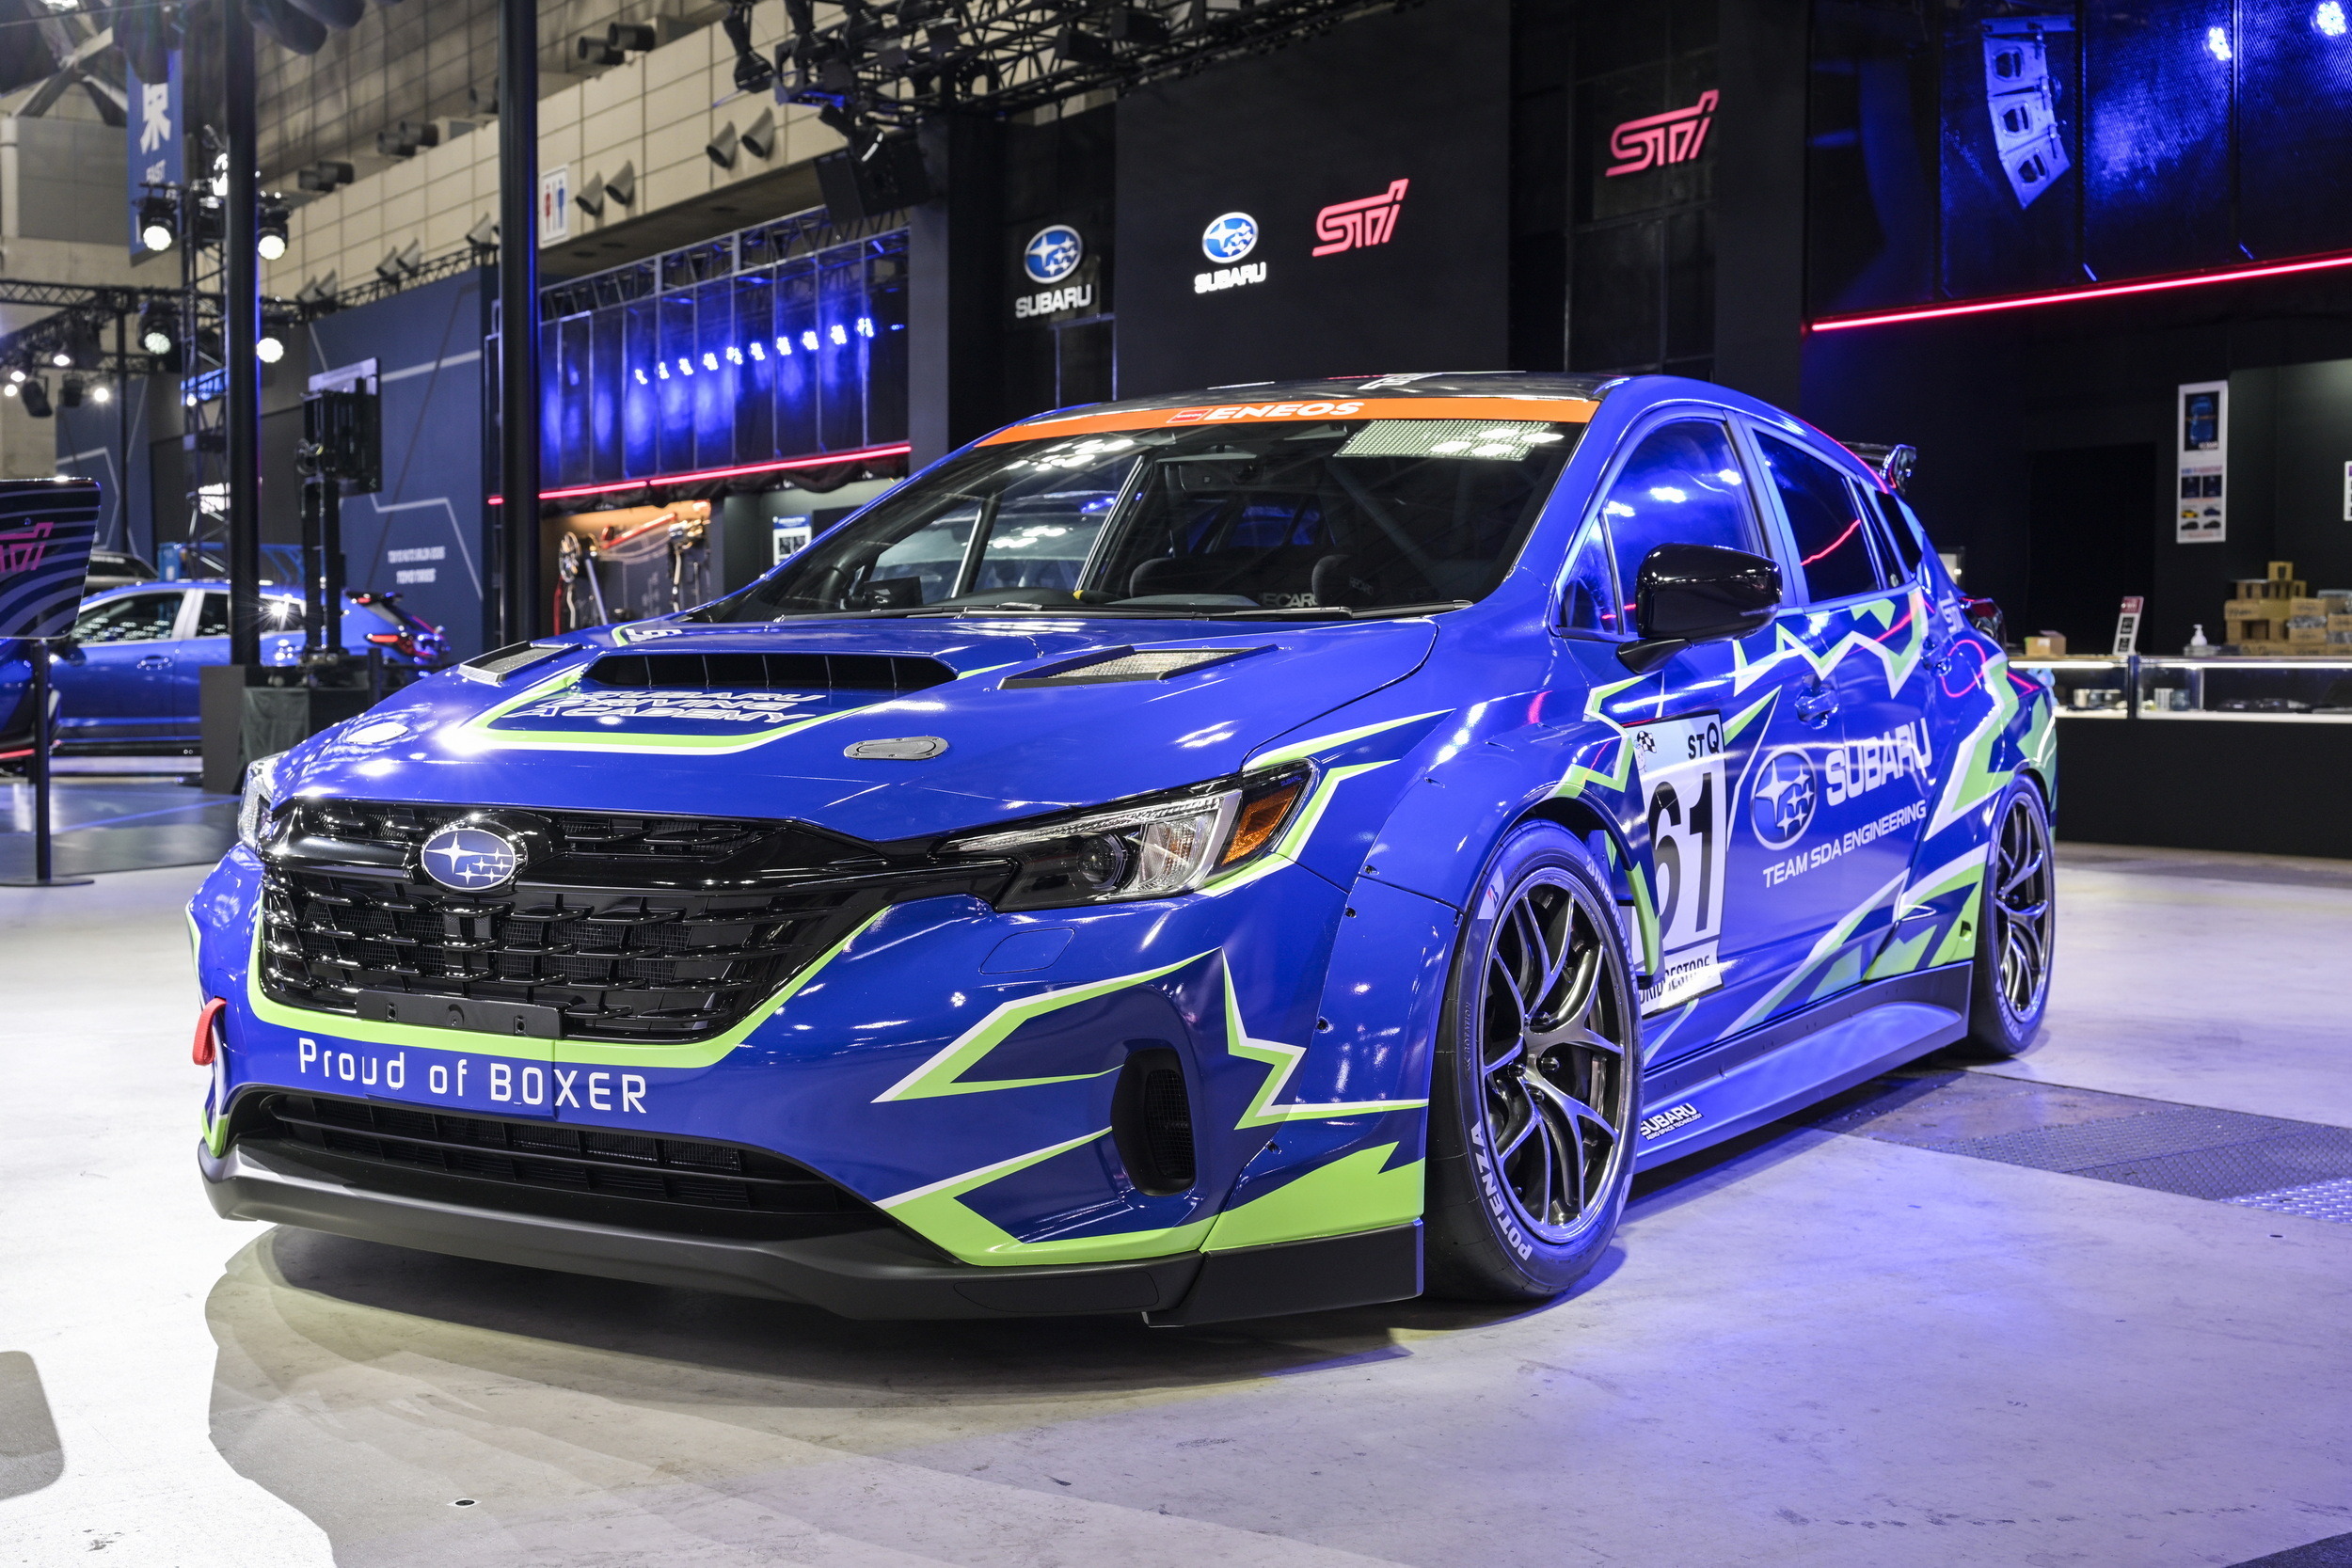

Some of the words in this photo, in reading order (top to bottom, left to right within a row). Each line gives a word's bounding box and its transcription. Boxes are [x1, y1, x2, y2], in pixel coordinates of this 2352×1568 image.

[1194, 261, 1267, 294] SUBARU
[1015, 283, 1091, 319] SUBARU
[1203, 402, 1365, 420] ENEOS
[1258, 593, 1318, 608] ECAR
[534, 697, 799, 711] DRIVING
[565, 690, 827, 702] SUBARU
[500, 705, 817, 723] ACADEMY
[1825, 717, 1932, 807] SUBARU
[1648, 772, 1713, 942] 61
[1762, 851, 1808, 888] TEAM
[1810, 838, 1842, 869] SDA
[1843, 800, 1927, 854] ENGINEERING
[299, 1037, 405, 1089] Proud
[429, 1058, 468, 1097] of
[490, 1062, 647, 1114] BOXER
[1640, 1102, 1698, 1136] SUBARU
[1470, 1121, 1534, 1261] POTENZA
